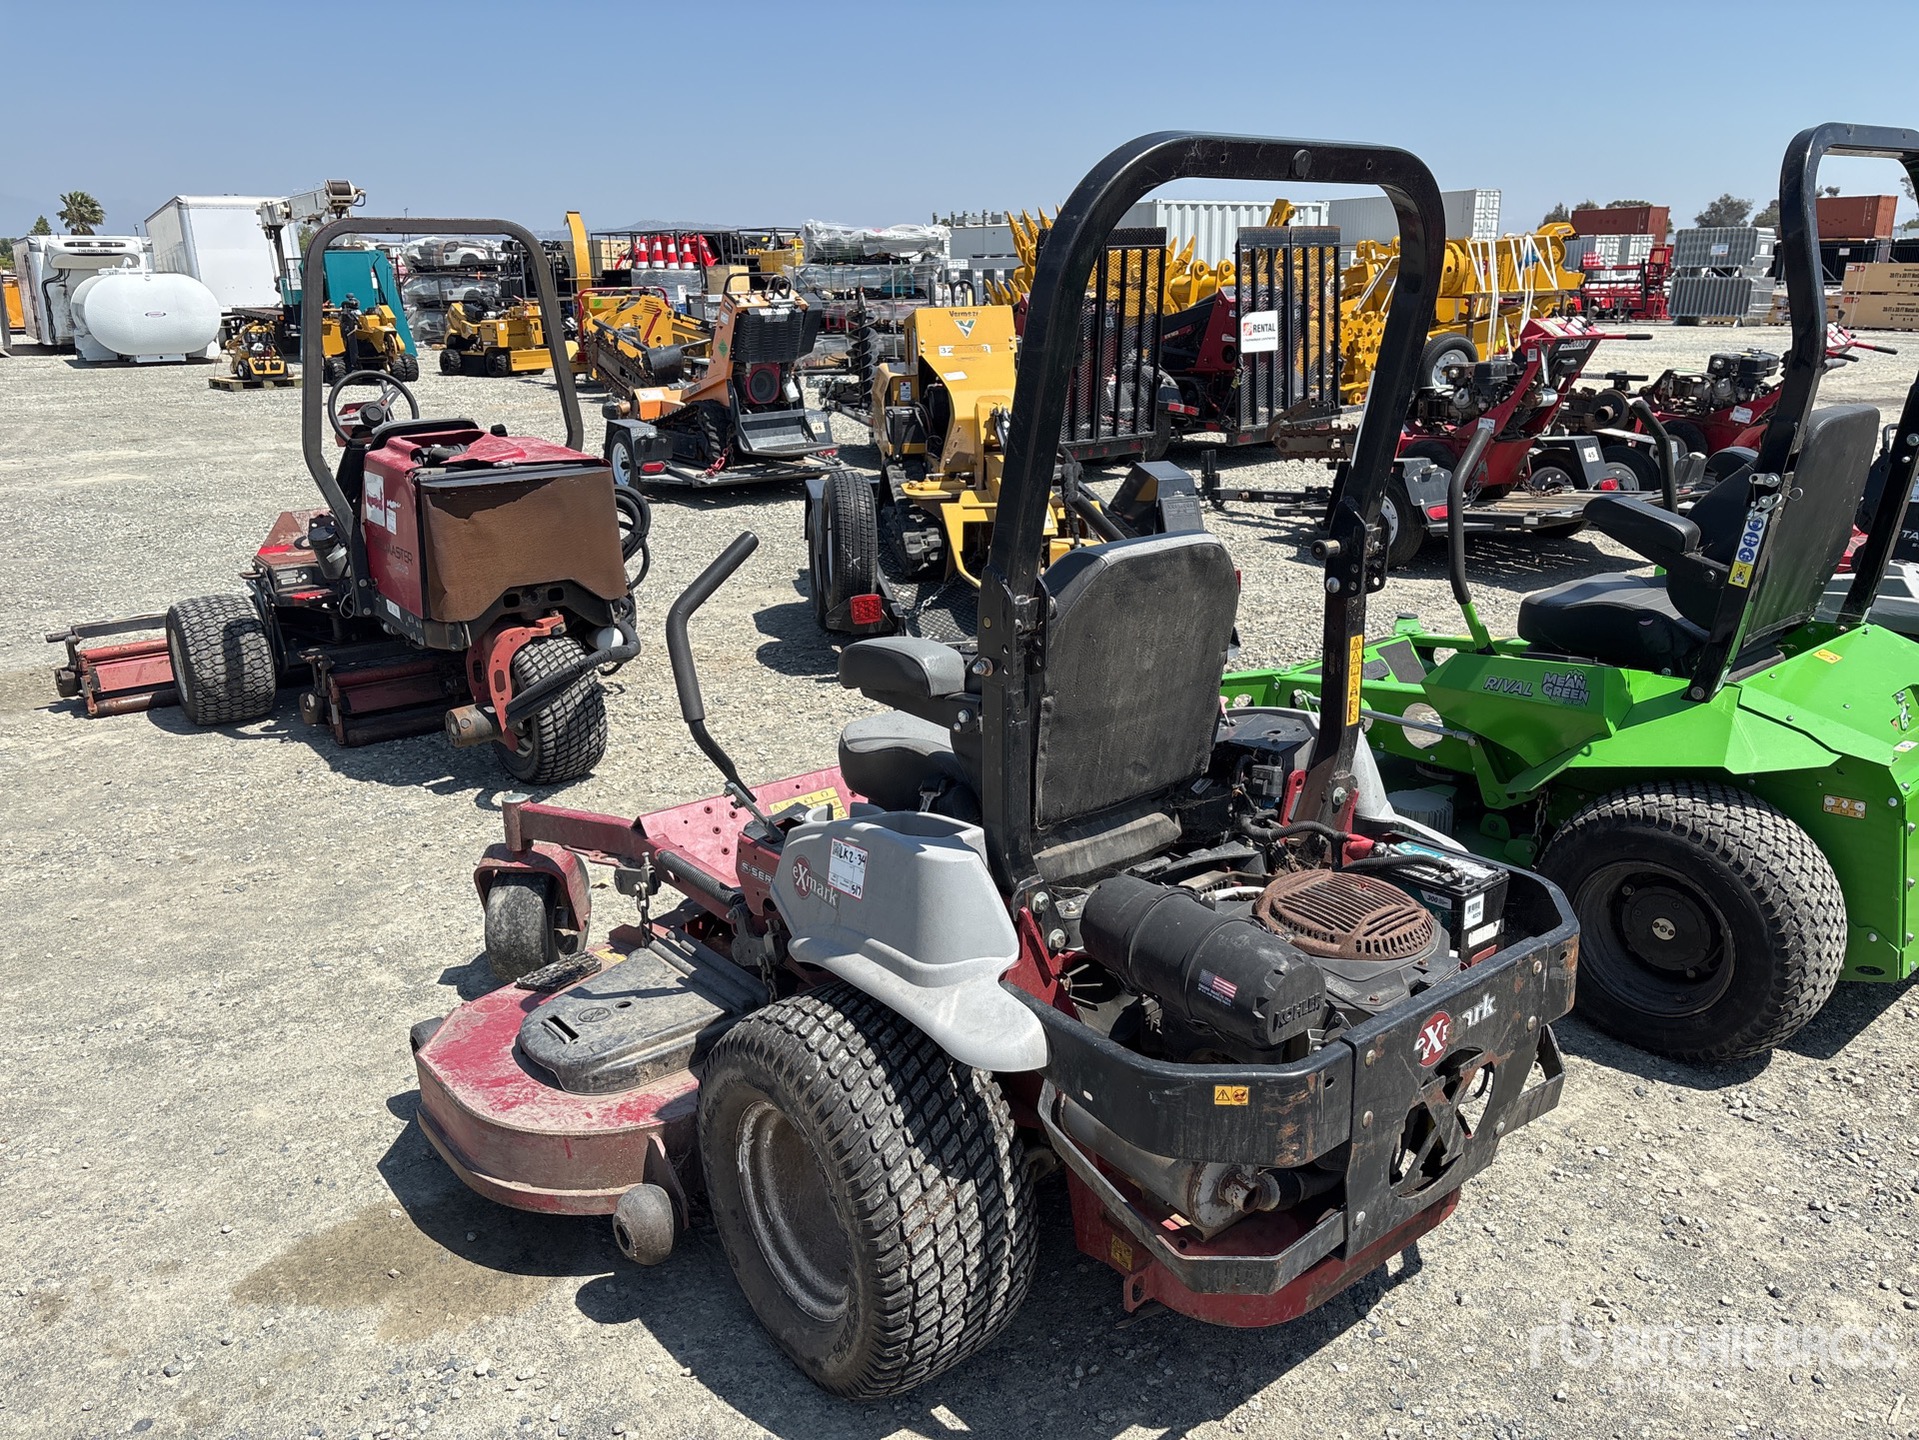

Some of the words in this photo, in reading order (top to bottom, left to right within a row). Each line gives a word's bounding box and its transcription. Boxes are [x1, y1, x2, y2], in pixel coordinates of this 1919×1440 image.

[680, 313, 702, 325] Vermeer
[949, 310, 979, 318] Vermeer
[1252, 323, 1276, 333] RENTAL
[1483, 676, 1533, 697] RIVAL
[1544, 672, 1586, 690] MEAN
[1542, 683, 1590, 706] GREEN
[792, 862, 838, 906] eXmark
[1426, 894, 1438, 903] 300
[1272, 992, 1323, 1032] KOHLER
